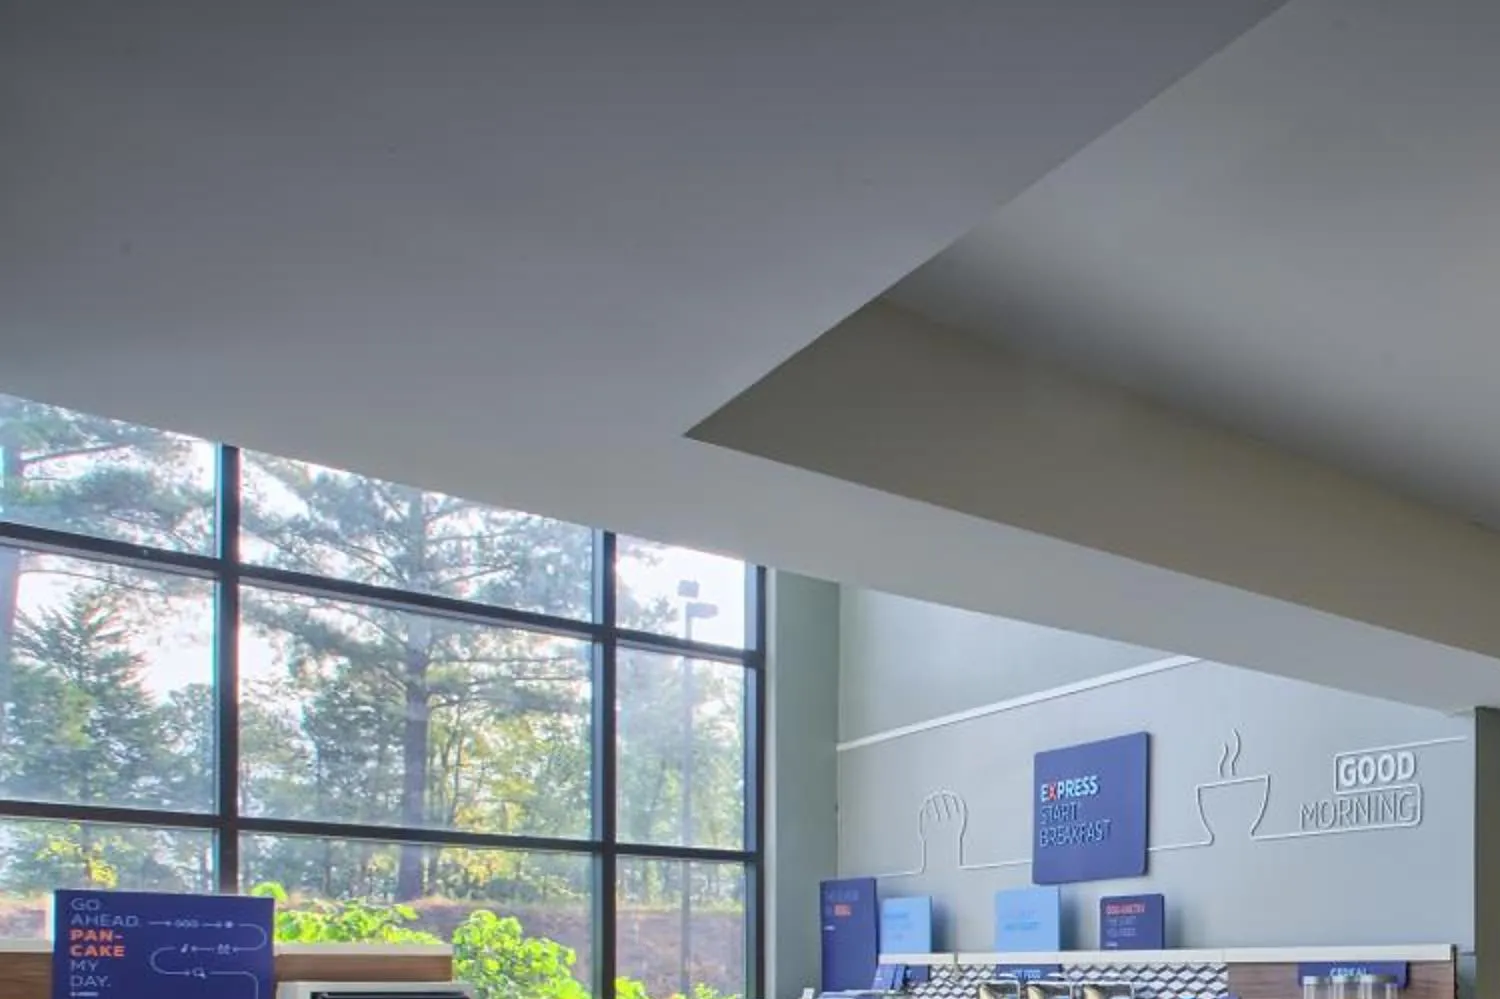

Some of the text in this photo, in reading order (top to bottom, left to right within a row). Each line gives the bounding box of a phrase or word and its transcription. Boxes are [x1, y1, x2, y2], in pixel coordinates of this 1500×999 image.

[1340, 751, 1416, 786] GOOD
[1040, 775, 1099, 802] EXPRESS
[1300, 791, 1416, 829] MORNING
[1040, 819, 1112, 847] BREAKFAST
[70, 897, 100, 912] GO
[70, 928, 124, 942] PAN-
[70, 944, 125, 958] CAKE
[70, 959, 99, 972] MY
[70, 975, 112, 988] DAY.
